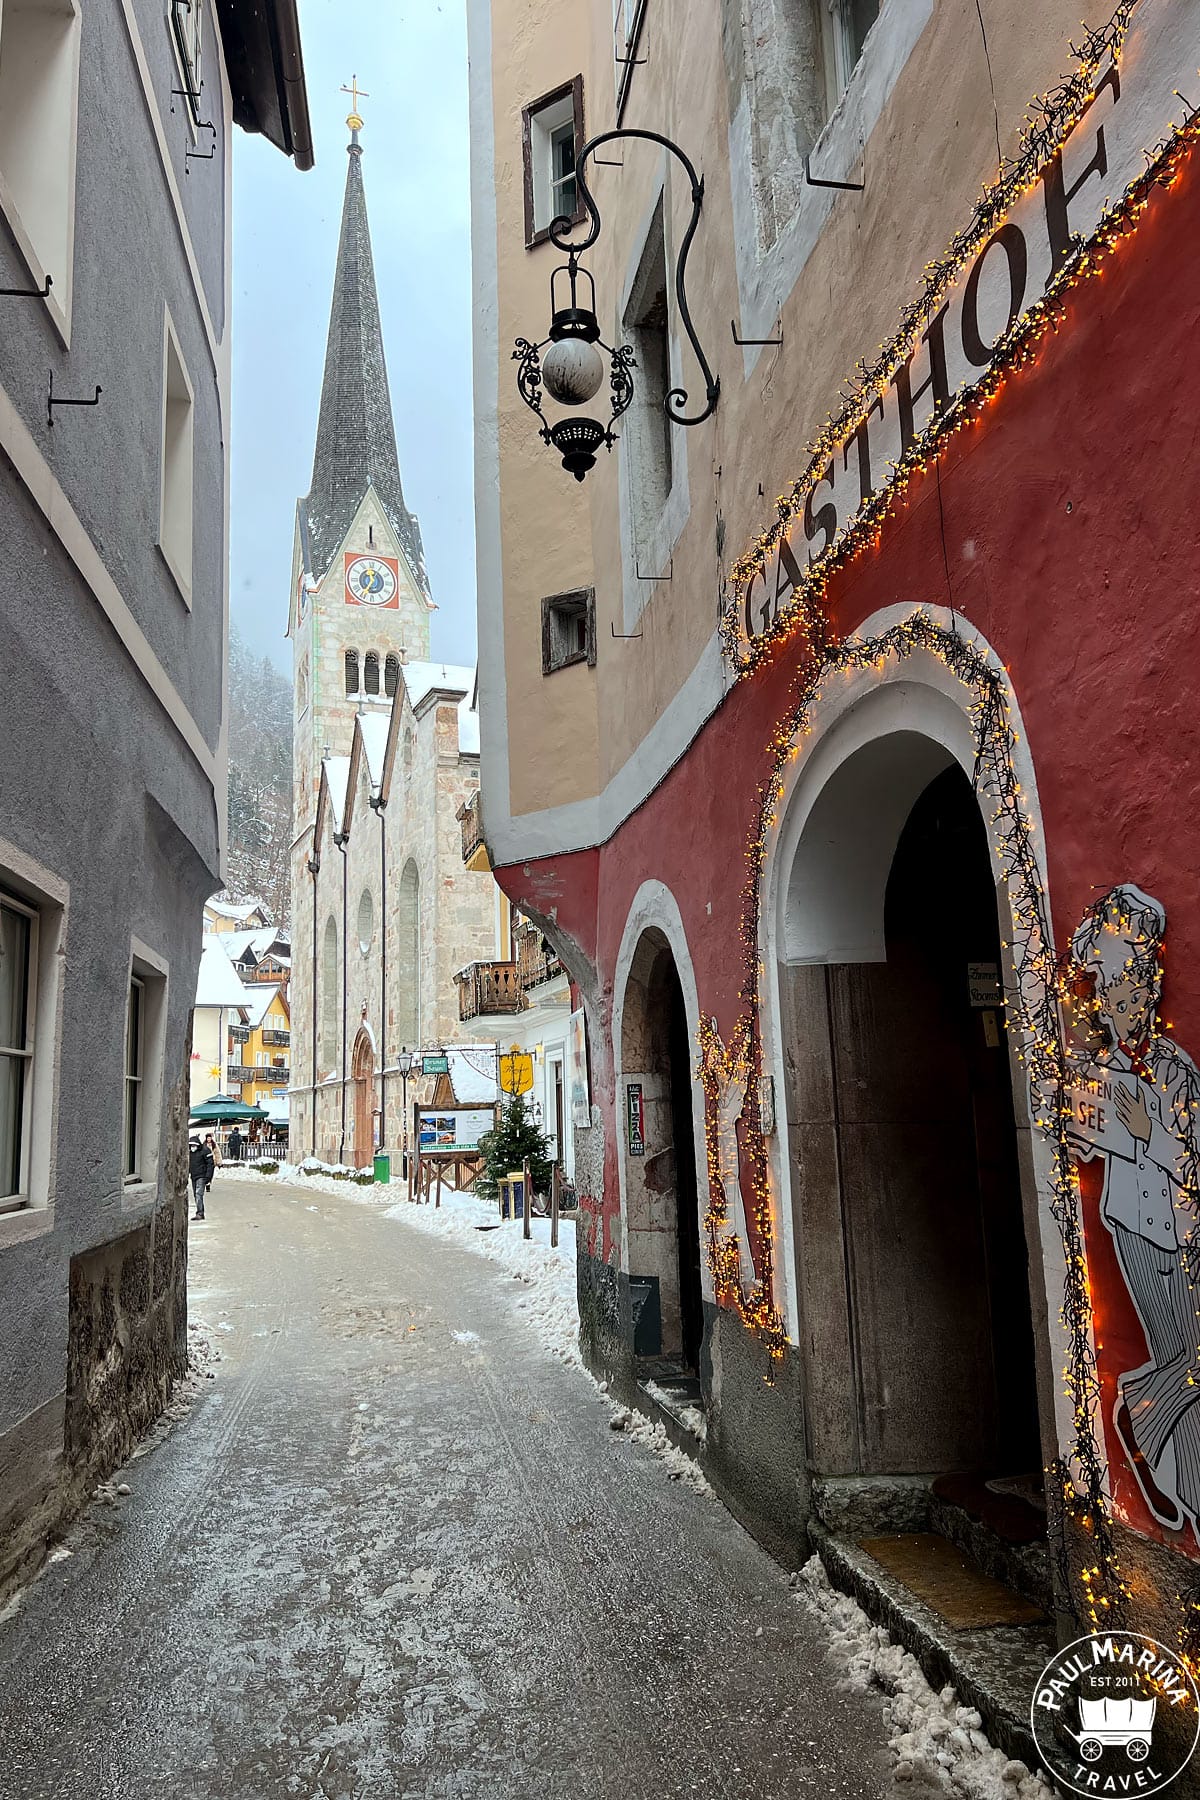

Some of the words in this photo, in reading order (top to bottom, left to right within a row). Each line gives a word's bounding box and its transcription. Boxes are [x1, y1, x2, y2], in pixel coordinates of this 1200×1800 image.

[744, 62, 1121, 640] GASTHOF
[971, 988, 999, 1001] Rooms
[630, 1093, 642, 1142] PIZZA
[1079, 1101, 1105, 1133] SEE
